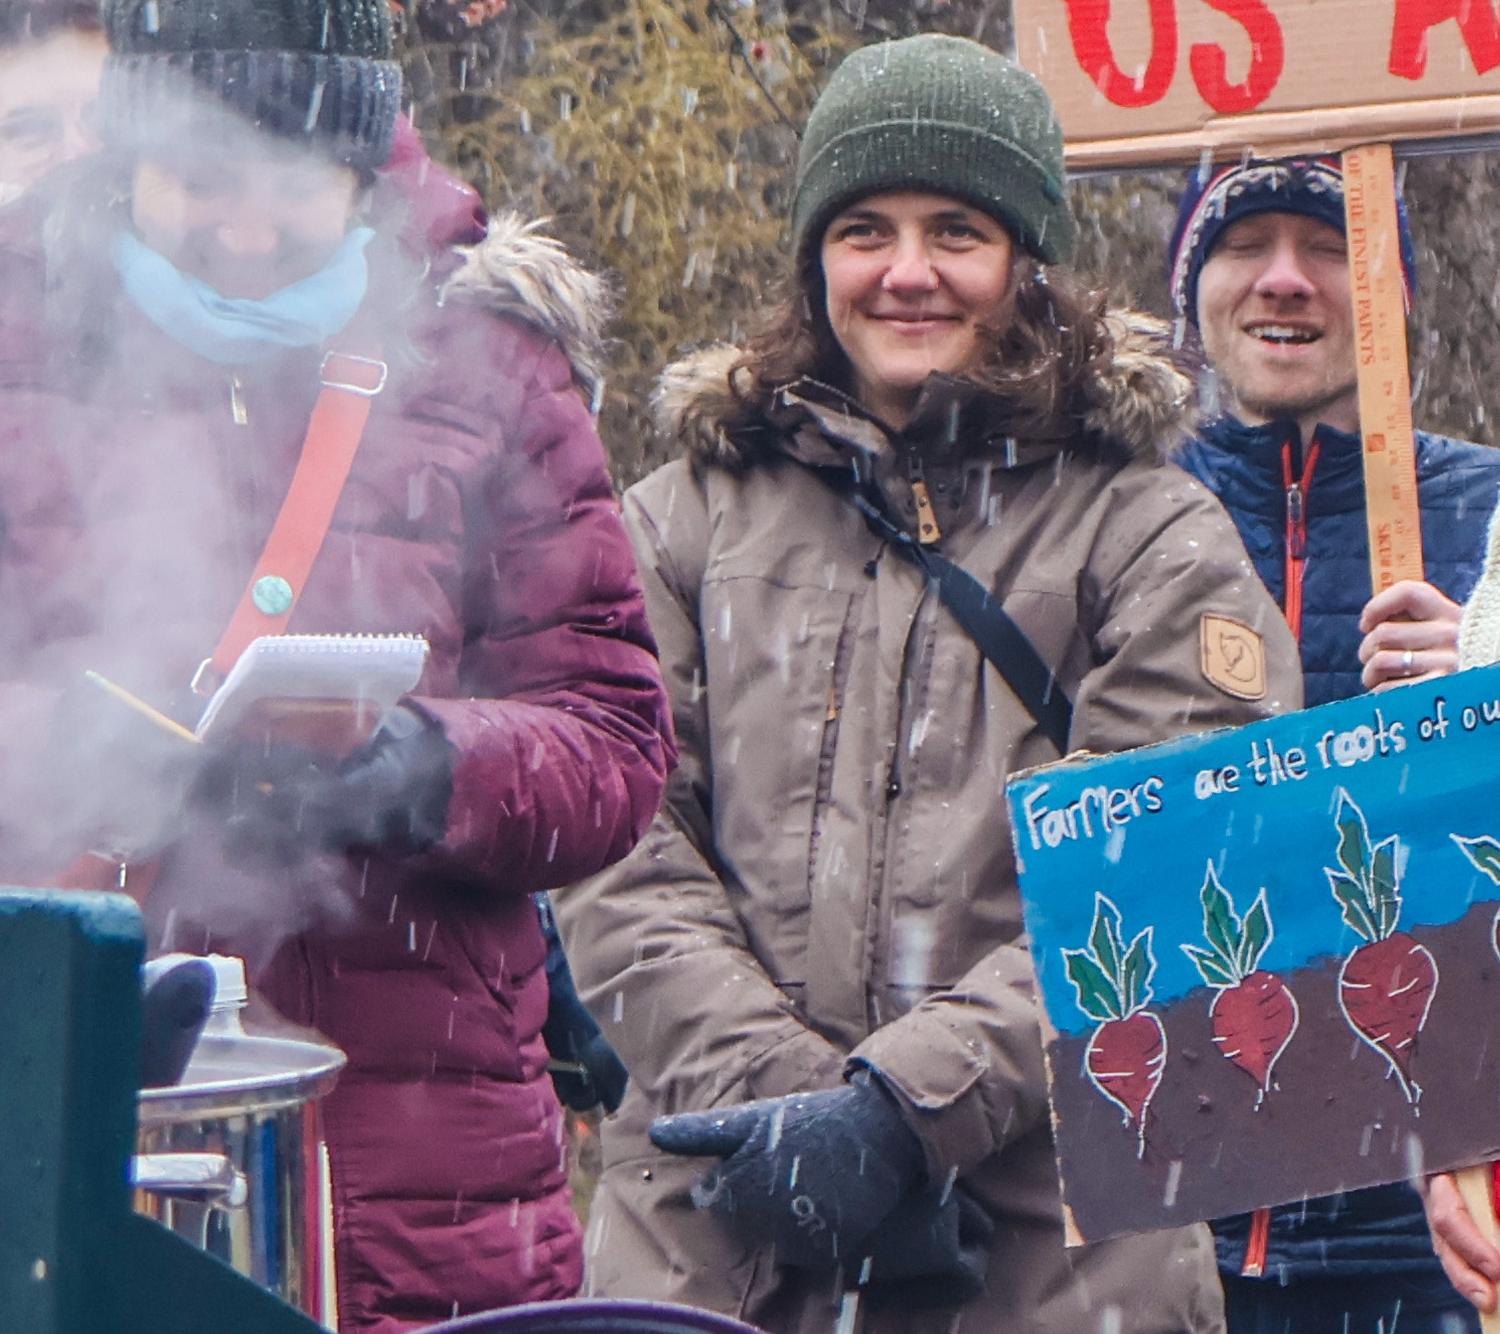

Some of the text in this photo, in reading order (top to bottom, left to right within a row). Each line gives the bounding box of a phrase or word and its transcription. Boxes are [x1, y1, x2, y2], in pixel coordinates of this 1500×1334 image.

[1350, 184, 1366, 223] THE
[1353, 227, 1371, 293] FINEST
[1357, 299, 1377, 366] PAINTS
[1022, 772, 1164, 851] Farmers
[1195, 766, 1240, 802] are
[1246, 739, 1307, 789] the
[1316, 719, 1407, 769] roots
[1418, 696, 1452, 743] of
